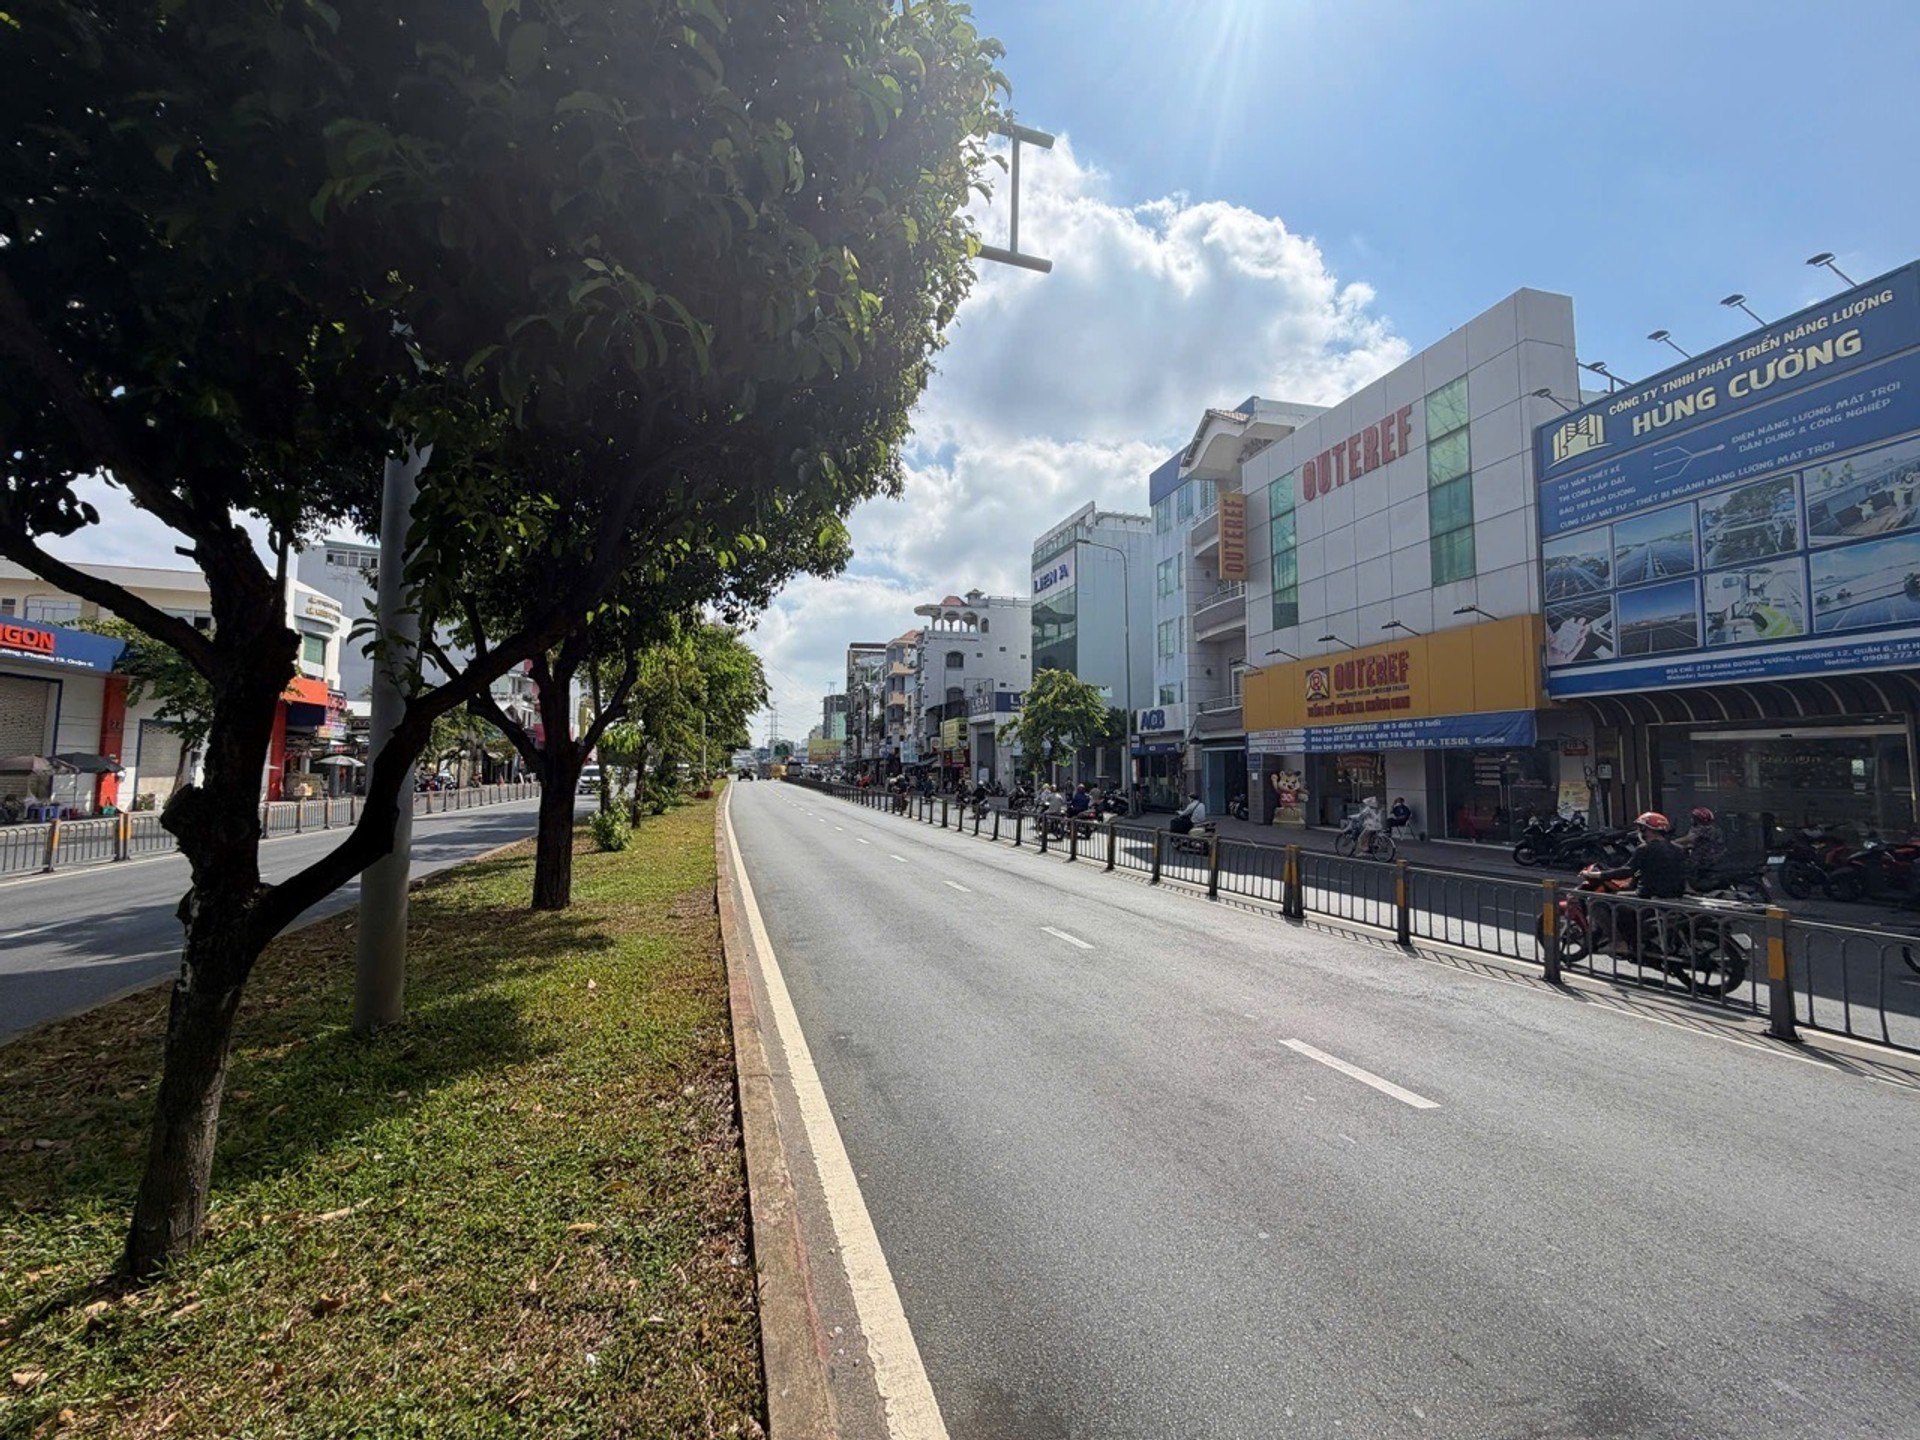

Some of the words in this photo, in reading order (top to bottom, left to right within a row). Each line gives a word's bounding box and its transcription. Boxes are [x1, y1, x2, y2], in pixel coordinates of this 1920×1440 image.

[1609, 395, 1640, 416] CÔNG
[1643, 387, 1658, 402] TY
[1661, 372, 1695, 394] TNHH
[1697, 355, 1734, 380] PHÁT
[1737, 333, 1780, 362] TRIỂN
[1831, 289, 1893, 324] LƯỢNG
[1632, 386, 1717, 437] HÙNG
[1728, 329, 1862, 398] CƯỜNG
[1303, 403, 1412, 501] OUTEREF
[1223, 499, 1244, 573] OUTEREF
[1334, 651, 1410, 691] OUTEREF
[1141, 710, 1165, 730] ACB
[1378, 740, 1403, 748] TESOL
[1440, 737, 1471, 746] TESOL
